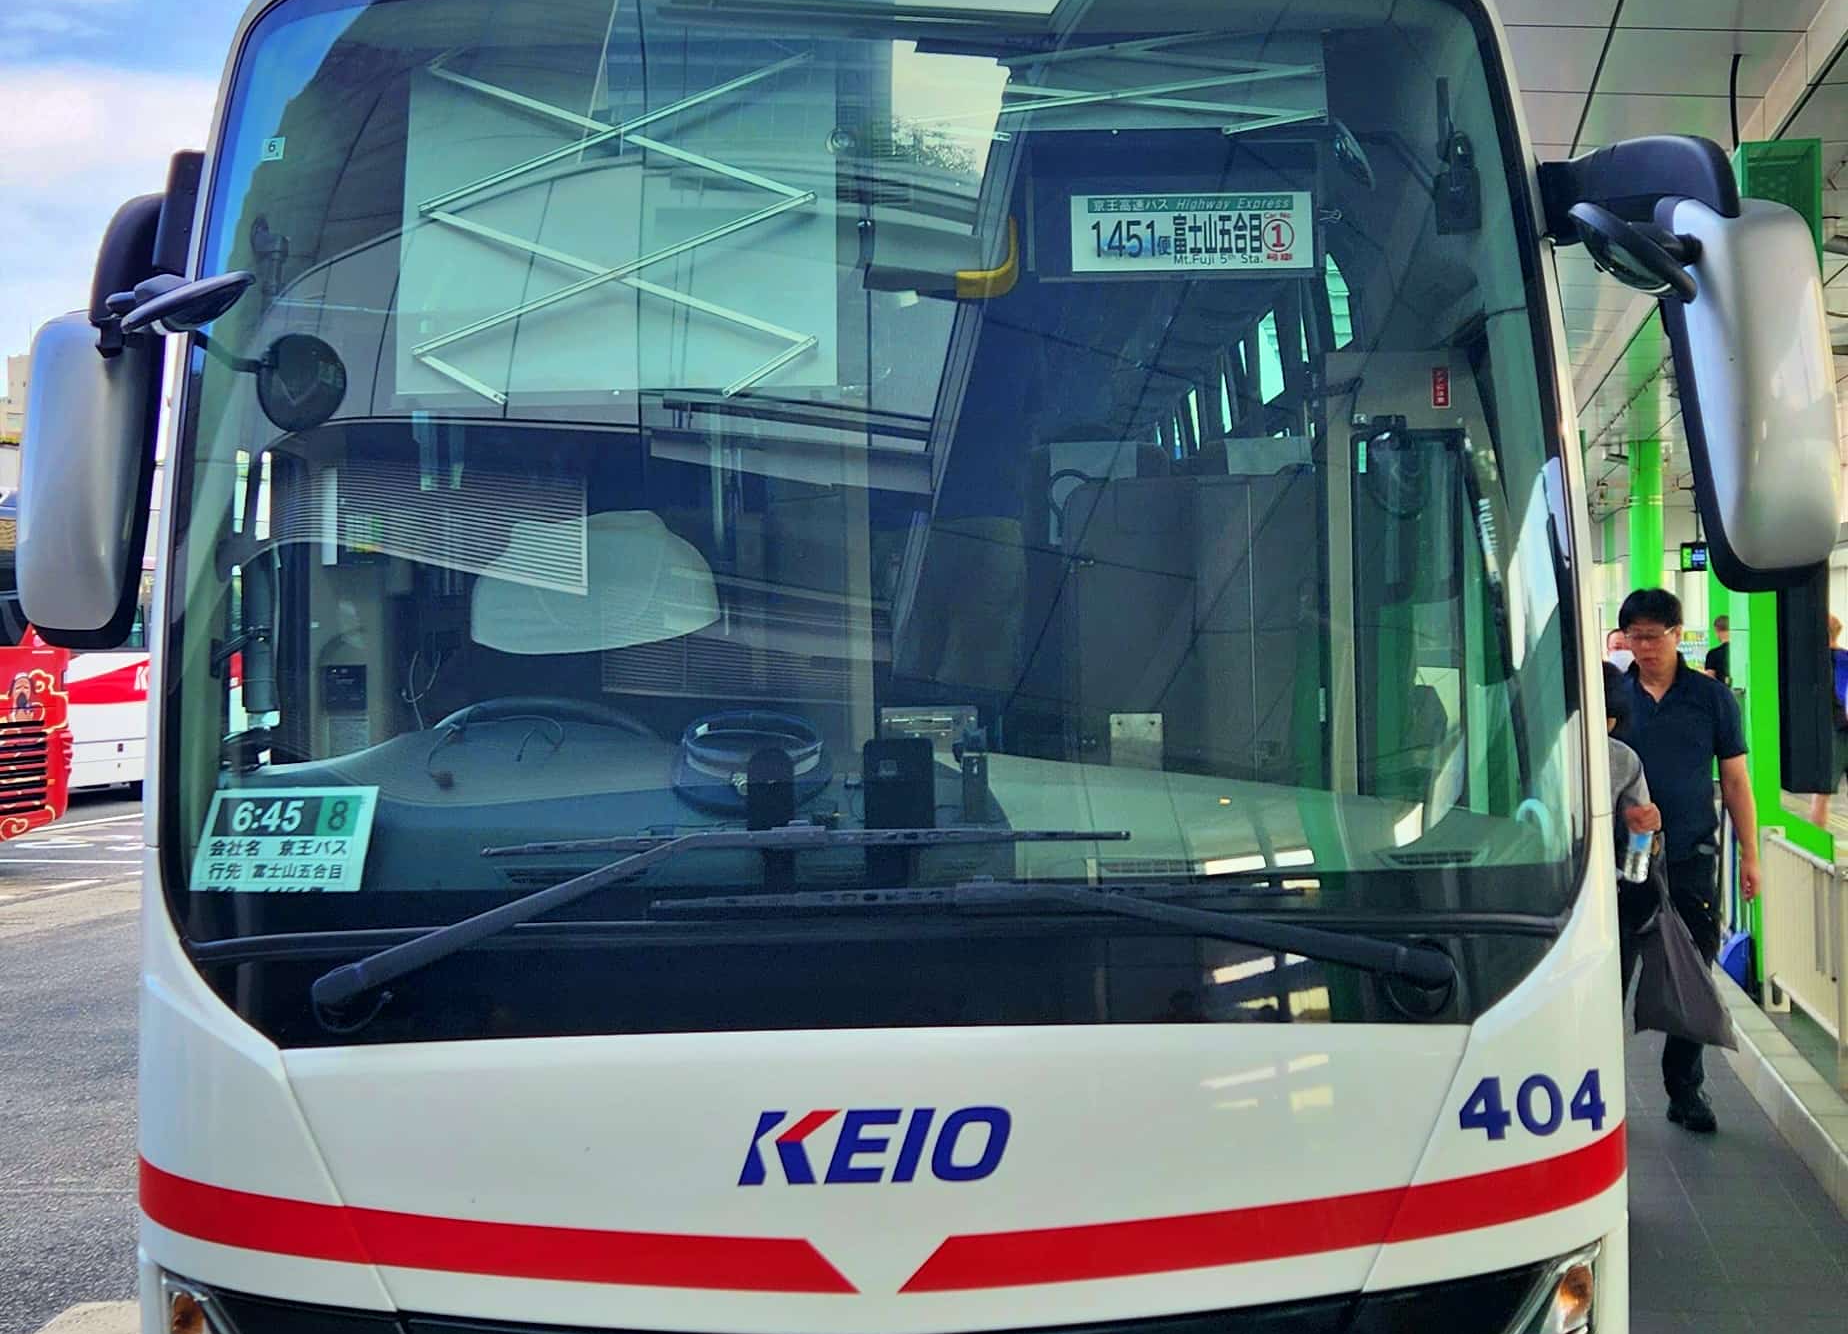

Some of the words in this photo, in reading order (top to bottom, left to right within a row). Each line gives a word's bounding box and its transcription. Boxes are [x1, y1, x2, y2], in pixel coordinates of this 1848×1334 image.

[1093, 199, 1168, 211] 京王高速バス
[1176, 199, 1231, 210] Highway
[1238, 198, 1290, 210] Express
[1172, 213, 1263, 255] 富士山五合目
[1241, 253, 1263, 264] Sta.
[231, 800, 304, 832] 6:45
[327, 800, 348, 831] 8
[209, 840, 262, 857] 会社名
[278, 839, 347, 856] 京王バス
[208, 862, 242, 879] 行先
[252, 863, 343, 879] 富士山五合目
[1459, 1068, 1606, 1141] 404
[737, 1106, 1012, 1186] KEIO
